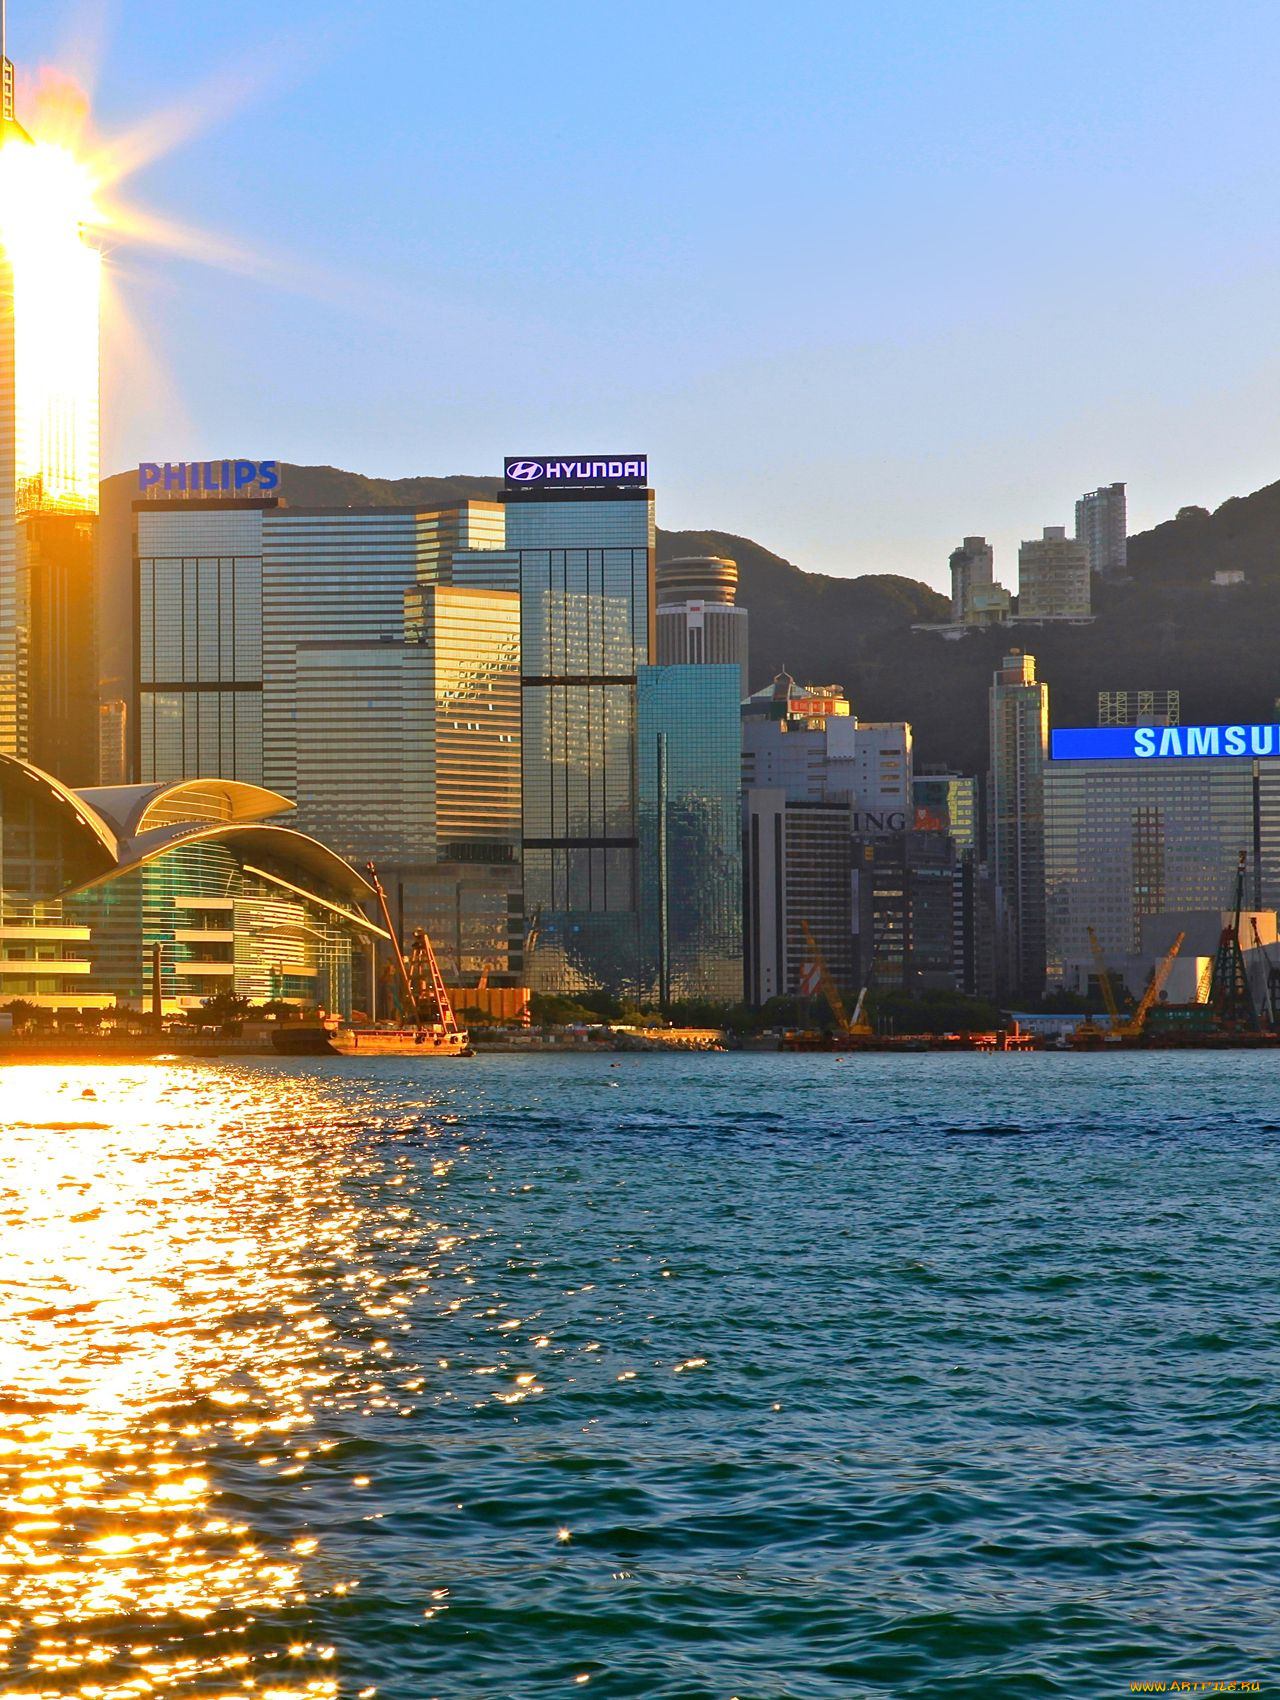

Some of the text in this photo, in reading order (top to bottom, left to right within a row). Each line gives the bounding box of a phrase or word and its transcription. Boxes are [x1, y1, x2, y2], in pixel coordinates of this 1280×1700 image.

[139, 461, 278, 490] PHILIPS
[546, 461, 645, 478] HYUNDAI
[1134, 726, 1280, 757] SAMSU
[853, 812, 905, 832] ING
